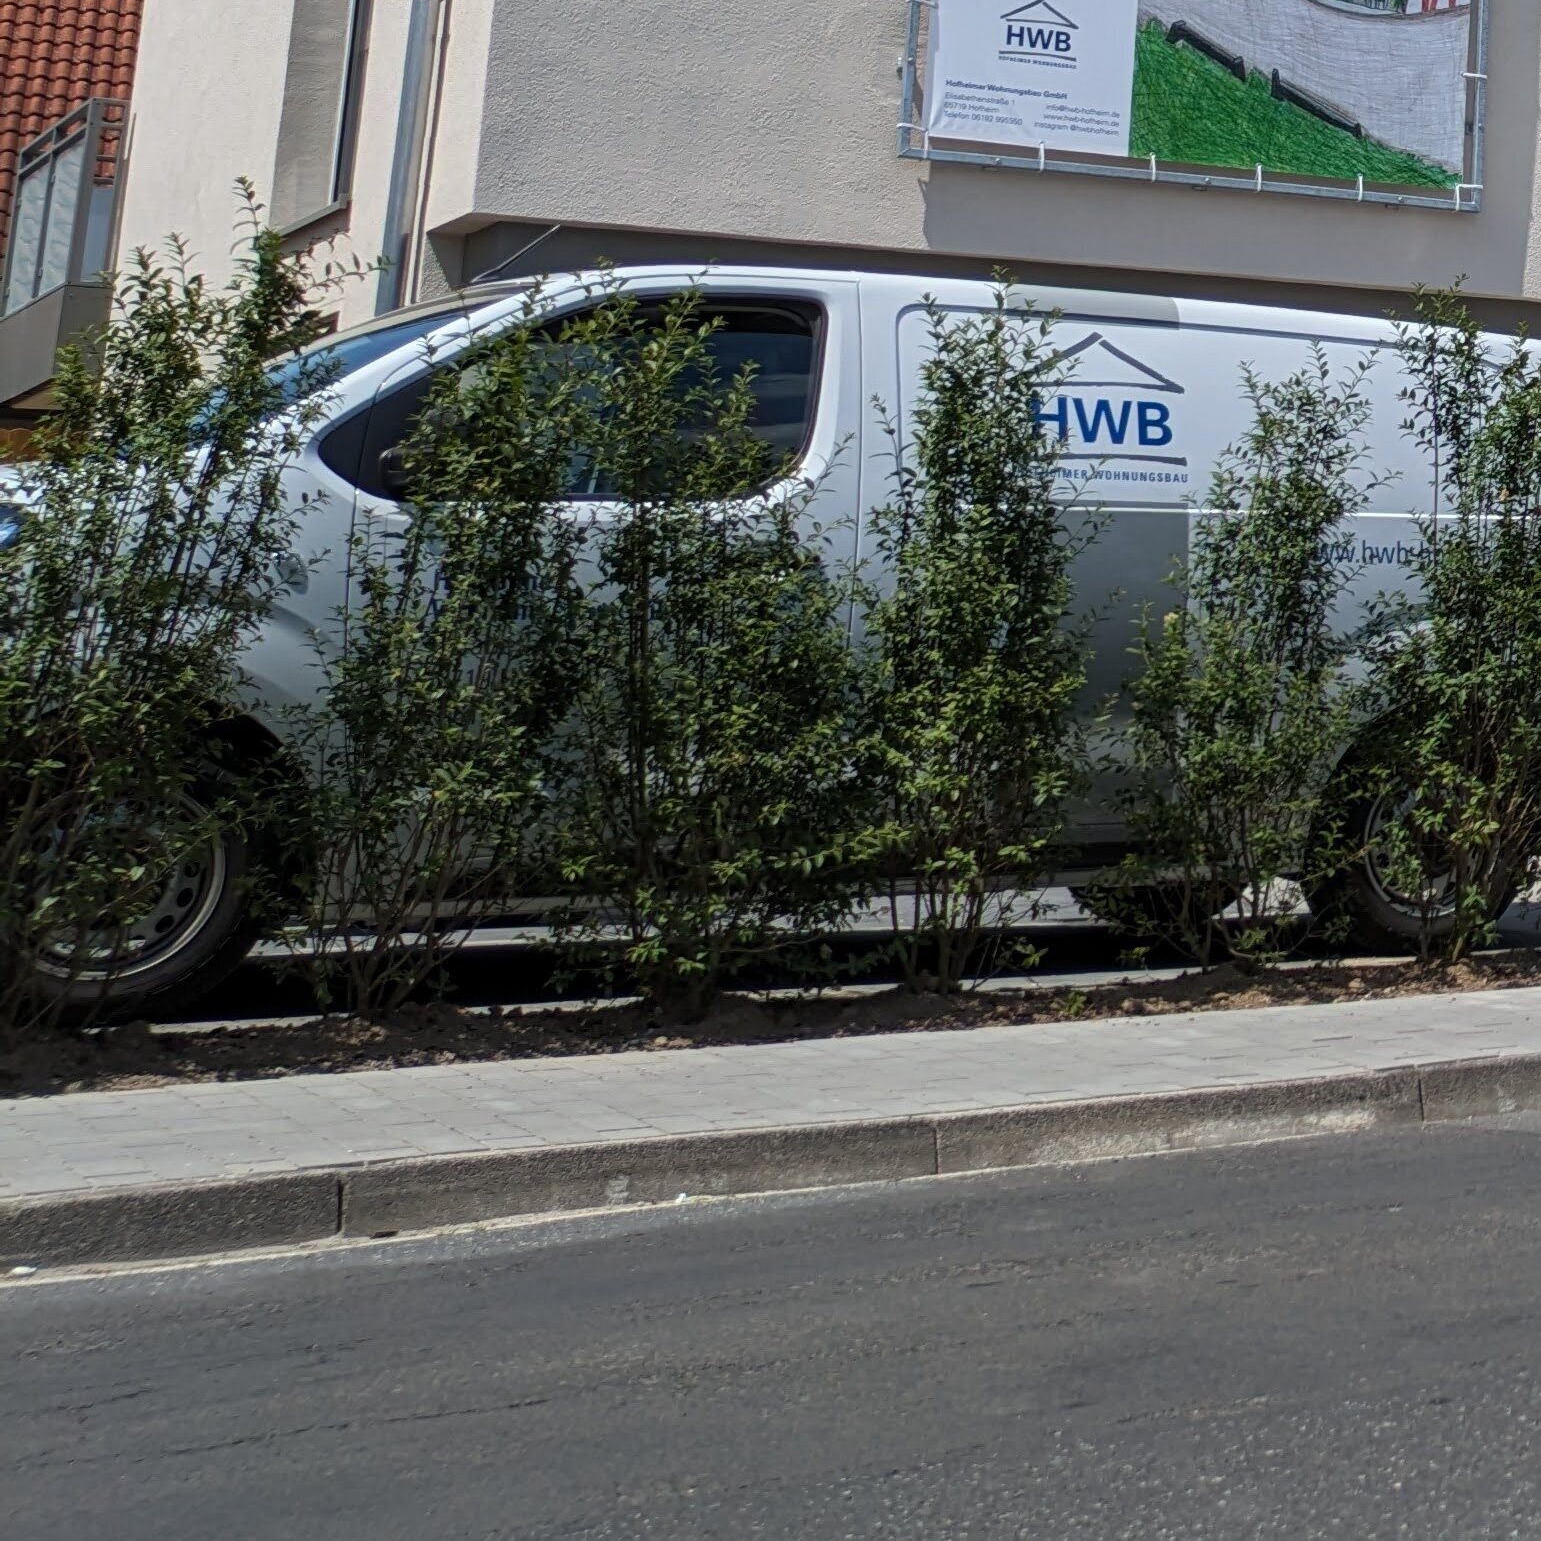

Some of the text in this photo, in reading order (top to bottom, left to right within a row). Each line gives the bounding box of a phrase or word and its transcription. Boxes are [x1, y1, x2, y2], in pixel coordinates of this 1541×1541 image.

[1006, 24, 1072, 52] HWB
[1031, 397, 1173, 446] HWB
[1094, 470, 1188, 483] WOHNUNGSBAU
